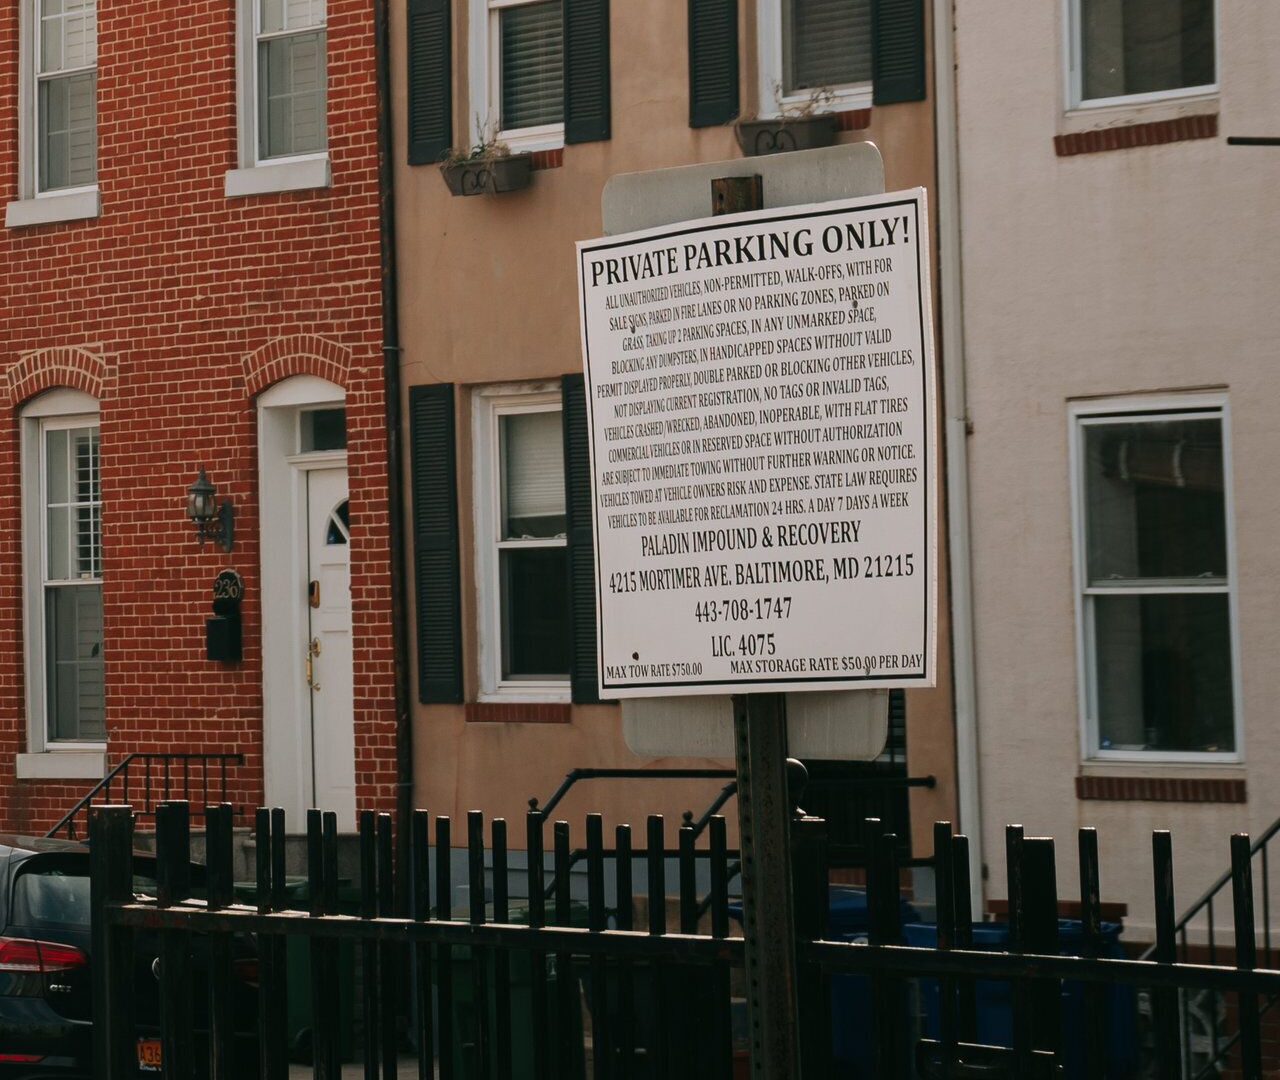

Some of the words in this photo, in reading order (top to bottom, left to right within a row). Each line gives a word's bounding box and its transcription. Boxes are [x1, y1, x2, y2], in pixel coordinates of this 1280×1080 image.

[591, 247, 678, 287] PRIVATE
[684, 229, 814, 271] PARKING
[822, 215, 909, 254] ONLY!
[620, 286, 669, 308] UNAUTHORIZED
[669, 280, 702, 299] VEHICLES,
[704, 269, 783, 293] NON-PERMITTED,
[786, 263, 845, 283] WALK-OFFS,
[846, 259, 872, 277] WITH
[875, 256, 893, 273] FOR
[610, 315, 627, 331] SALE
[649, 307, 672, 325] PARKED
[681, 303, 696, 319] FIRE
[698, 299, 722, 317] LANES
[724, 298, 737, 313] OR
[739, 296, 751, 312] NO
[755, 291, 798, 310] PARKING
[802, 287, 836, 305] ZONES,
[839, 282, 875, 303] PARKED
[877, 280, 890, 297] ON
[622, 335, 644, 351] GRASS,
[683, 323, 714, 341] PARKING
[716, 319, 749, 337] SPACES,
[751, 318, 762, 333] IN
[764, 316, 784, 332] ANY
[787, 309, 845, 330] UNMARKED
[848, 304, 876, 324] SPACE,
[612, 356, 645, 374] BLOCKING
[659, 348, 699, 368] DUMPSTERS,
[710, 339, 774, 360] HANDICAPPED
[777, 336, 812, 353] SPACES
[814, 330, 863, 350] WITHOUT
[865, 327, 892, 345] VALID
[597, 382, 623, 398] PERMIT
[624, 377, 658, 395] DISPLAYED
[659, 372, 692, 390] PROPERLY,
[694, 367, 724, 385] DOUBLE
[726, 364, 762, 381] PARKED
[765, 362, 778, 377] OR
[781, 357, 831, 376] BLOCKING
[833, 354, 866, 371] OTHER
[868, 349, 914, 368] VEHICLES,
[614, 403, 628, 418] NOT
[629, 398, 665, 416] DISPLAYING
[666, 393, 697, 411] CURRENT
[699, 387, 761, 407] REGISTRATION,
[764, 385, 777, 401] NO
[780, 383, 803, 399] TAGS
[806, 381, 820, 397] OR
[822, 377, 861, 395] INVALID
[864, 375, 889, 392] TAGS,
[604, 424, 634, 441] VEHICLES
[635, 416, 702, 438] CRASHED/WRECKED,
[703, 410, 757, 429] ABANDONED,
[760, 404, 822, 424] INOPERABLE,
[825, 402, 851, 418] WITH
[854, 399, 877, 416] FLAT
[880, 396, 908, 414] TIRES
[609, 445, 650, 463] COMMERCIAL
[650, 441, 680, 458] VEHICLES
[702, 434, 743, 452] RESERVED
[745, 432, 771, 448] SPACE
[774, 427, 821, 445] WITHOUT
[822, 421, 902, 442] AUTHORIZATION
[615, 467, 641, 484] SUBJECT
[652, 462, 689, 480] IMMEDIATE
[691, 459, 721, 476] TOWING
[723, 455, 765, 473] WITHOUT
[768, 451, 811, 469] FURTHER
[813, 448, 859, 465] WARNING
[861, 446, 875, 462] OR
[877, 443, 915, 461] NOTICE.
[600, 491, 630, 508] VEHICLES
[630, 489, 654, 504] TOWED
[663, 485, 692, 501] VEHICLE
[693, 482, 726, 499] OWNERS
[727, 480, 746, 496] RISK
[748, 478, 767, 494] AND
[769, 475, 812, 492] EXPENSE.
[814, 472, 842, 489] STATE
[845, 471, 867, 487] LAW
[869, 467, 917, 488] REQUIRES
[608, 512, 638, 529] VEHICLES
[657, 507, 693, 524] AVAILABLE
[694, 506, 709, 521] FOR
[711, 501, 770, 520] RECLAMATION
[772, 500, 783, 515] 24
[785, 498, 806, 514] HRS.
[807, 498, 814, 513] A
[817, 496, 836, 512] DAY
[837, 497, 844, 511] 7
[846, 494, 870, 510] DAYS
[871, 493, 878, 509] A
[880, 491, 909, 508] WEEK
[642, 532, 689, 556] PALADIN
[692, 526, 757, 552] IMPOUND
[762, 525, 773, 548] &
[778, 520, 861, 546] RECOVERY
[215, 579, 238, 599] 236
[609, 571, 637, 593] 4215
[639, 566, 700, 591] MORTIMER
[704, 564, 732, 587] AVE.
[735, 558, 829, 585] BALTIMORE,
[834, 556, 859, 579] MD
[864, 553, 915, 578] 21215
[694, 596, 792, 622] 443-708-1747
[711, 634, 735, 657] LIC.
[738, 633, 776, 656] 4075
[730, 660, 753, 673] MAX
[755, 658, 806, 672] STORAGE
[809, 657, 839, 671] RATE
[842, 655, 876, 671] $50.00
[879, 654, 899, 668] PER
[901, 654, 923, 668] DAY
[606, 665, 627, 678] MAX
[629, 664, 650, 678] TOW
[651, 663, 671, 676] RATE
[672, 662, 703, 676] $750.00
